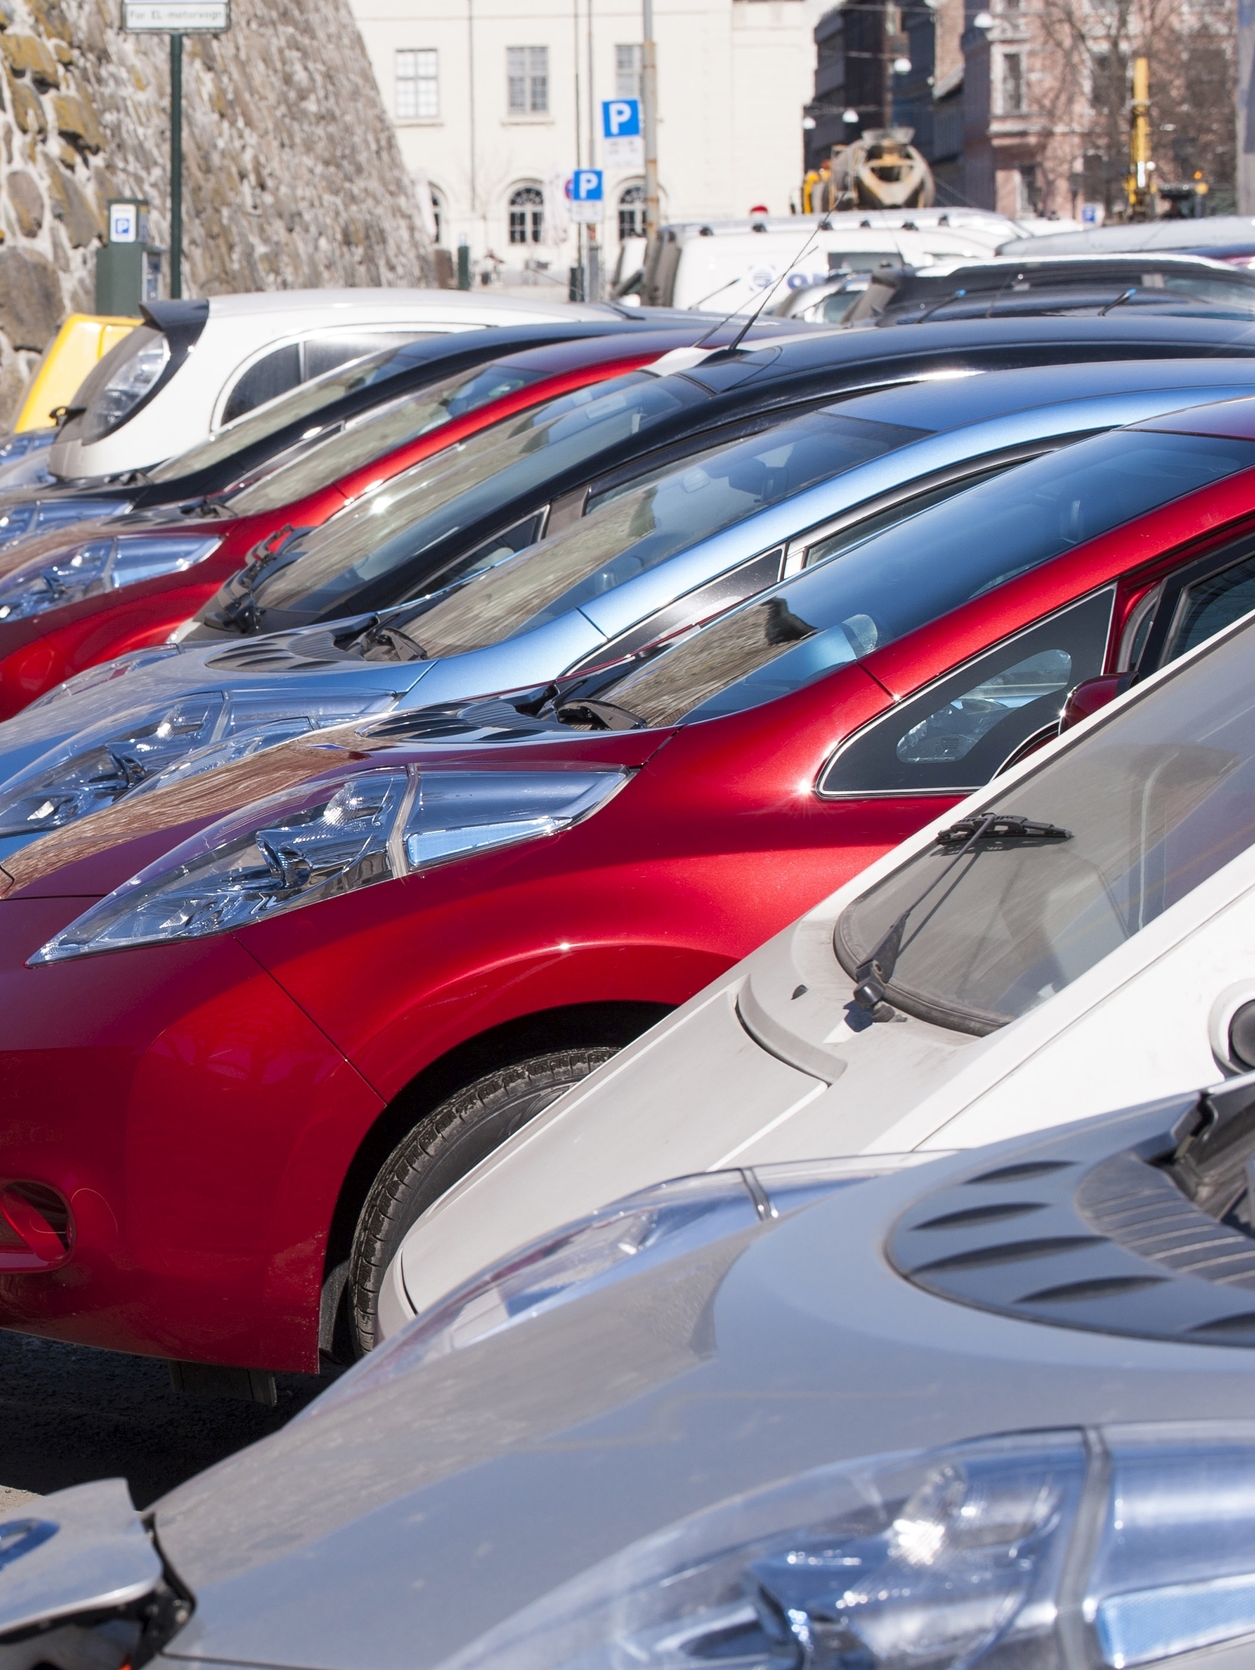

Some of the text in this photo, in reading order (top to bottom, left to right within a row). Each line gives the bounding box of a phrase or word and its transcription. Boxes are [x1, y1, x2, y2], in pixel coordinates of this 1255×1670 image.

[609, 102, 632, 135] P
[579, 172, 598, 199] P
[117, 219, 129, 233] P
